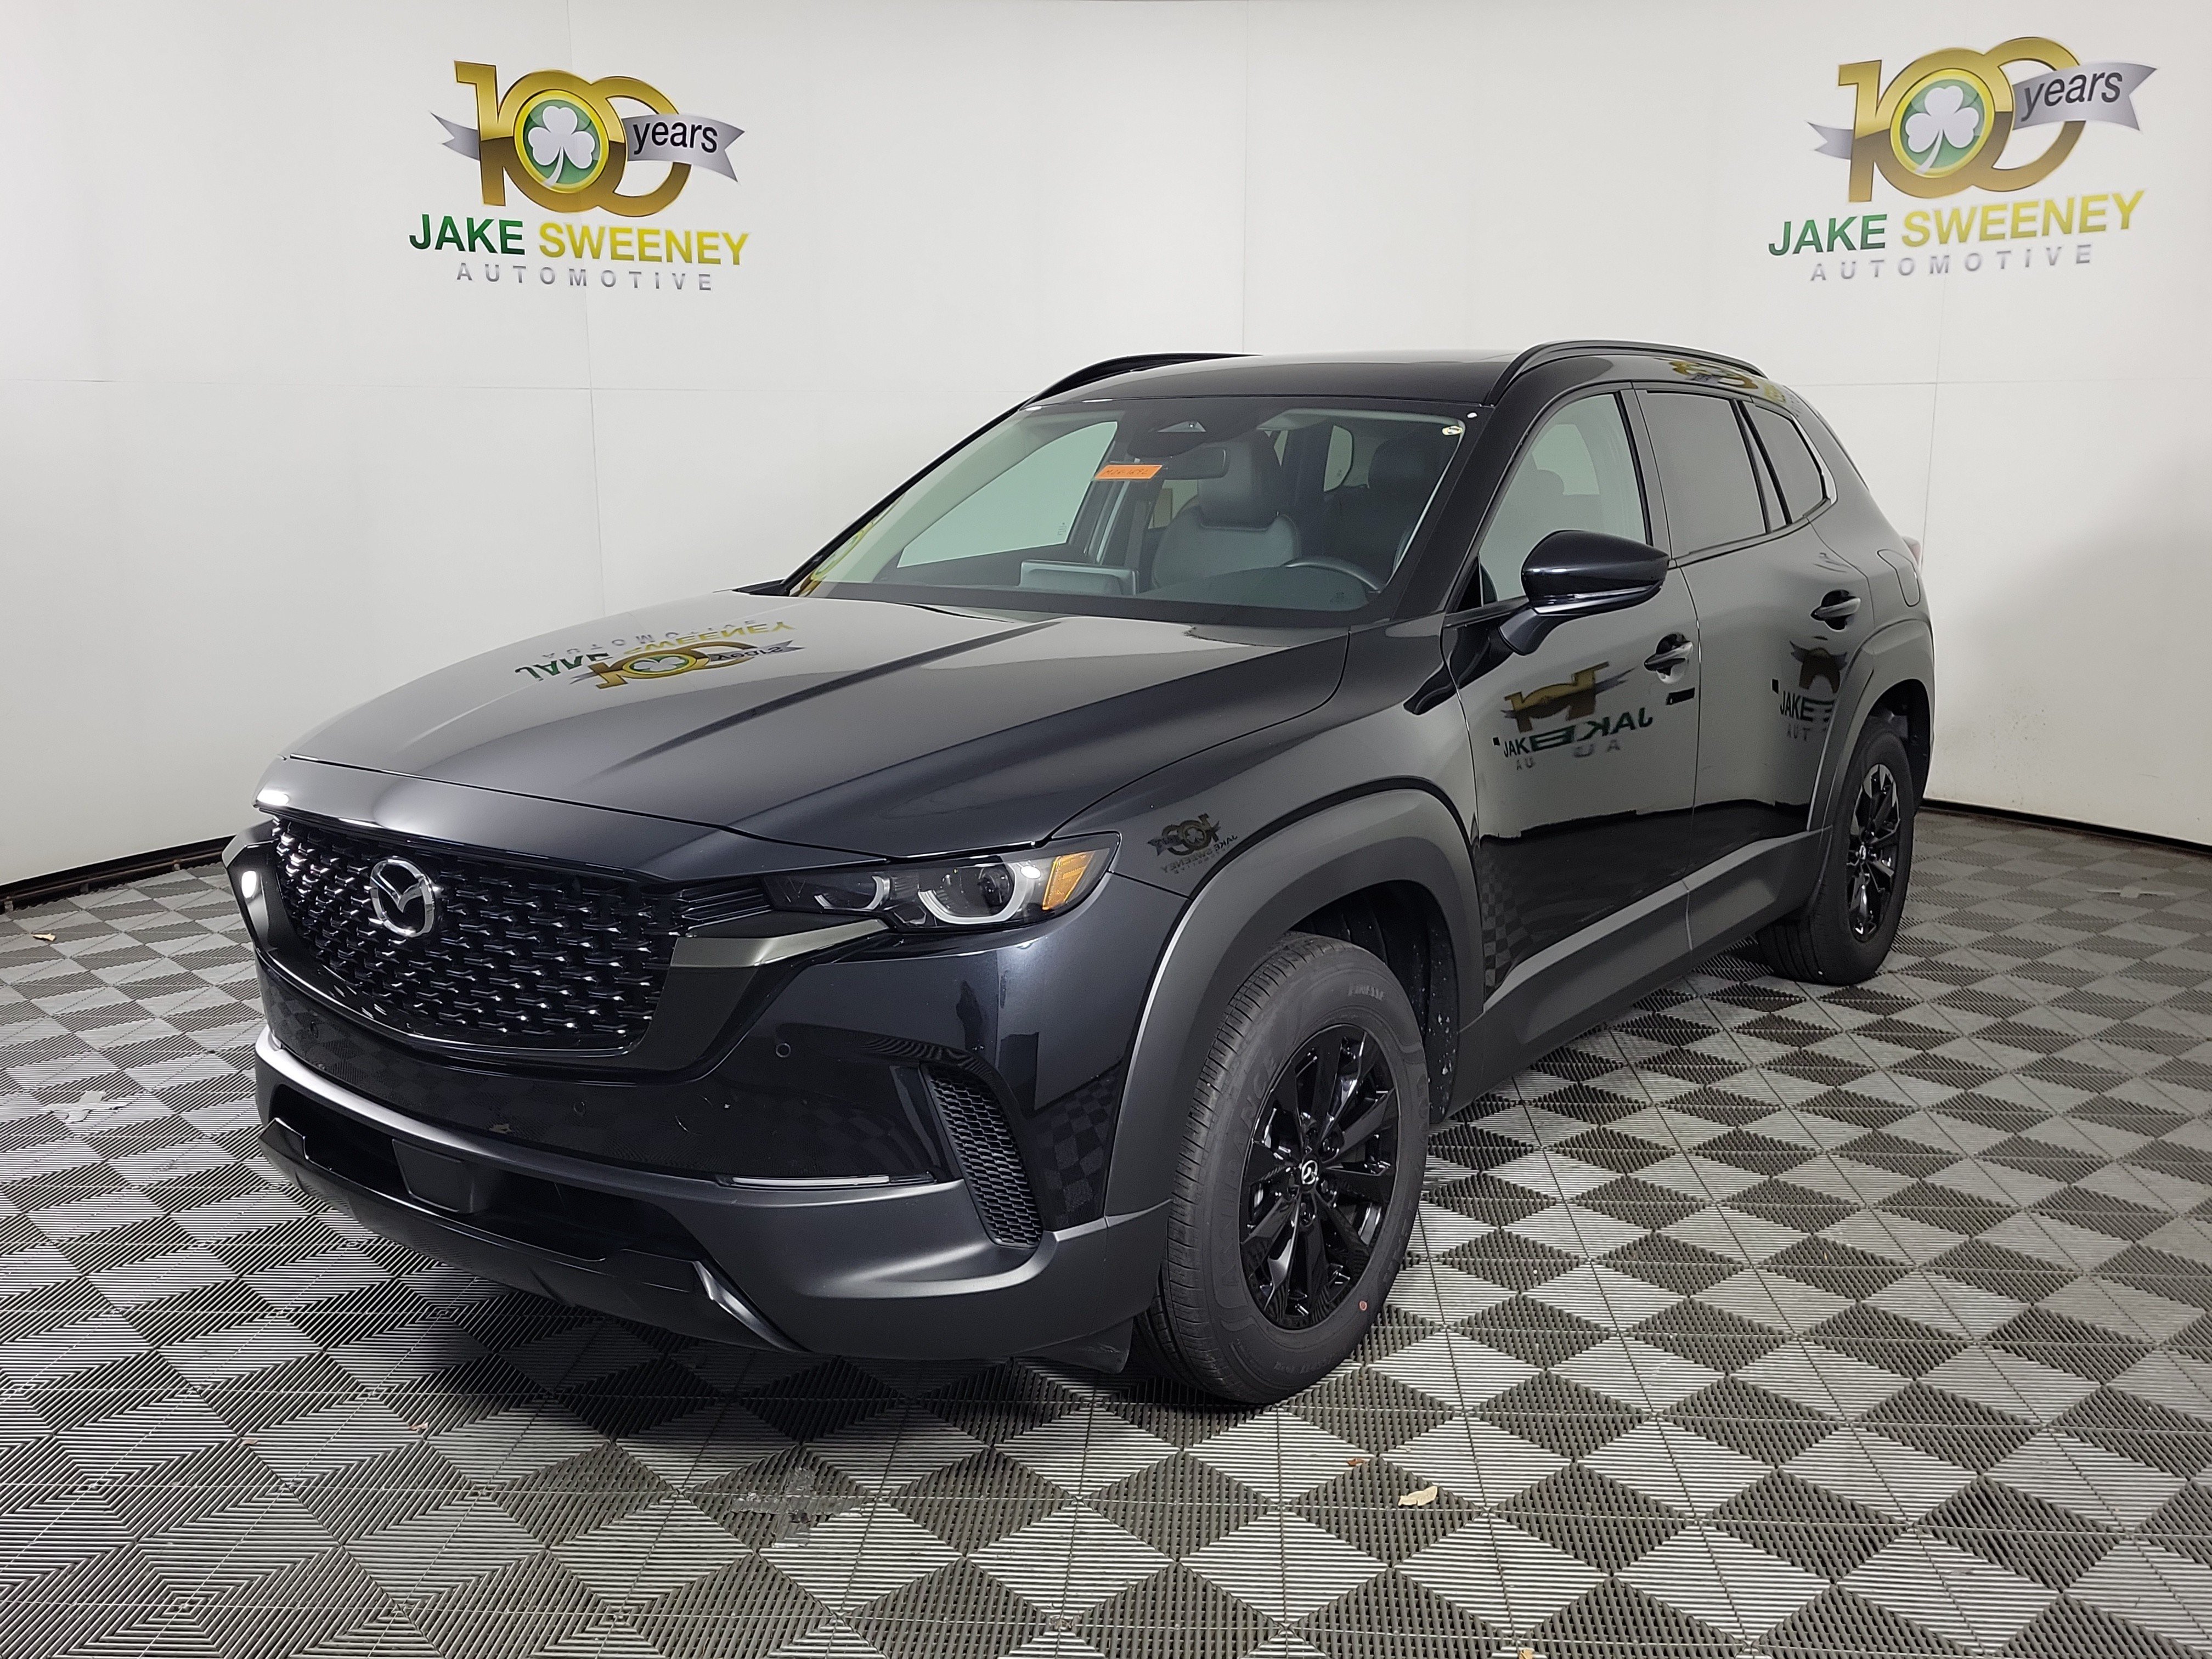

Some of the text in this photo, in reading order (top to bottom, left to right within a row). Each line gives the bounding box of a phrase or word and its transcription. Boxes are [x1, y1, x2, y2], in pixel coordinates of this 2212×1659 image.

[2021, 72, 2123, 122] years
[633, 121, 718, 154] years
[409, 213, 749, 266] JAKE SWEENEY
[1768, 190, 2145, 256] JAKE SWEENEY
[455, 262, 712, 291] AUTOMOTIVE
[1810, 244, 2092, 281] AUTOMOTIVE
